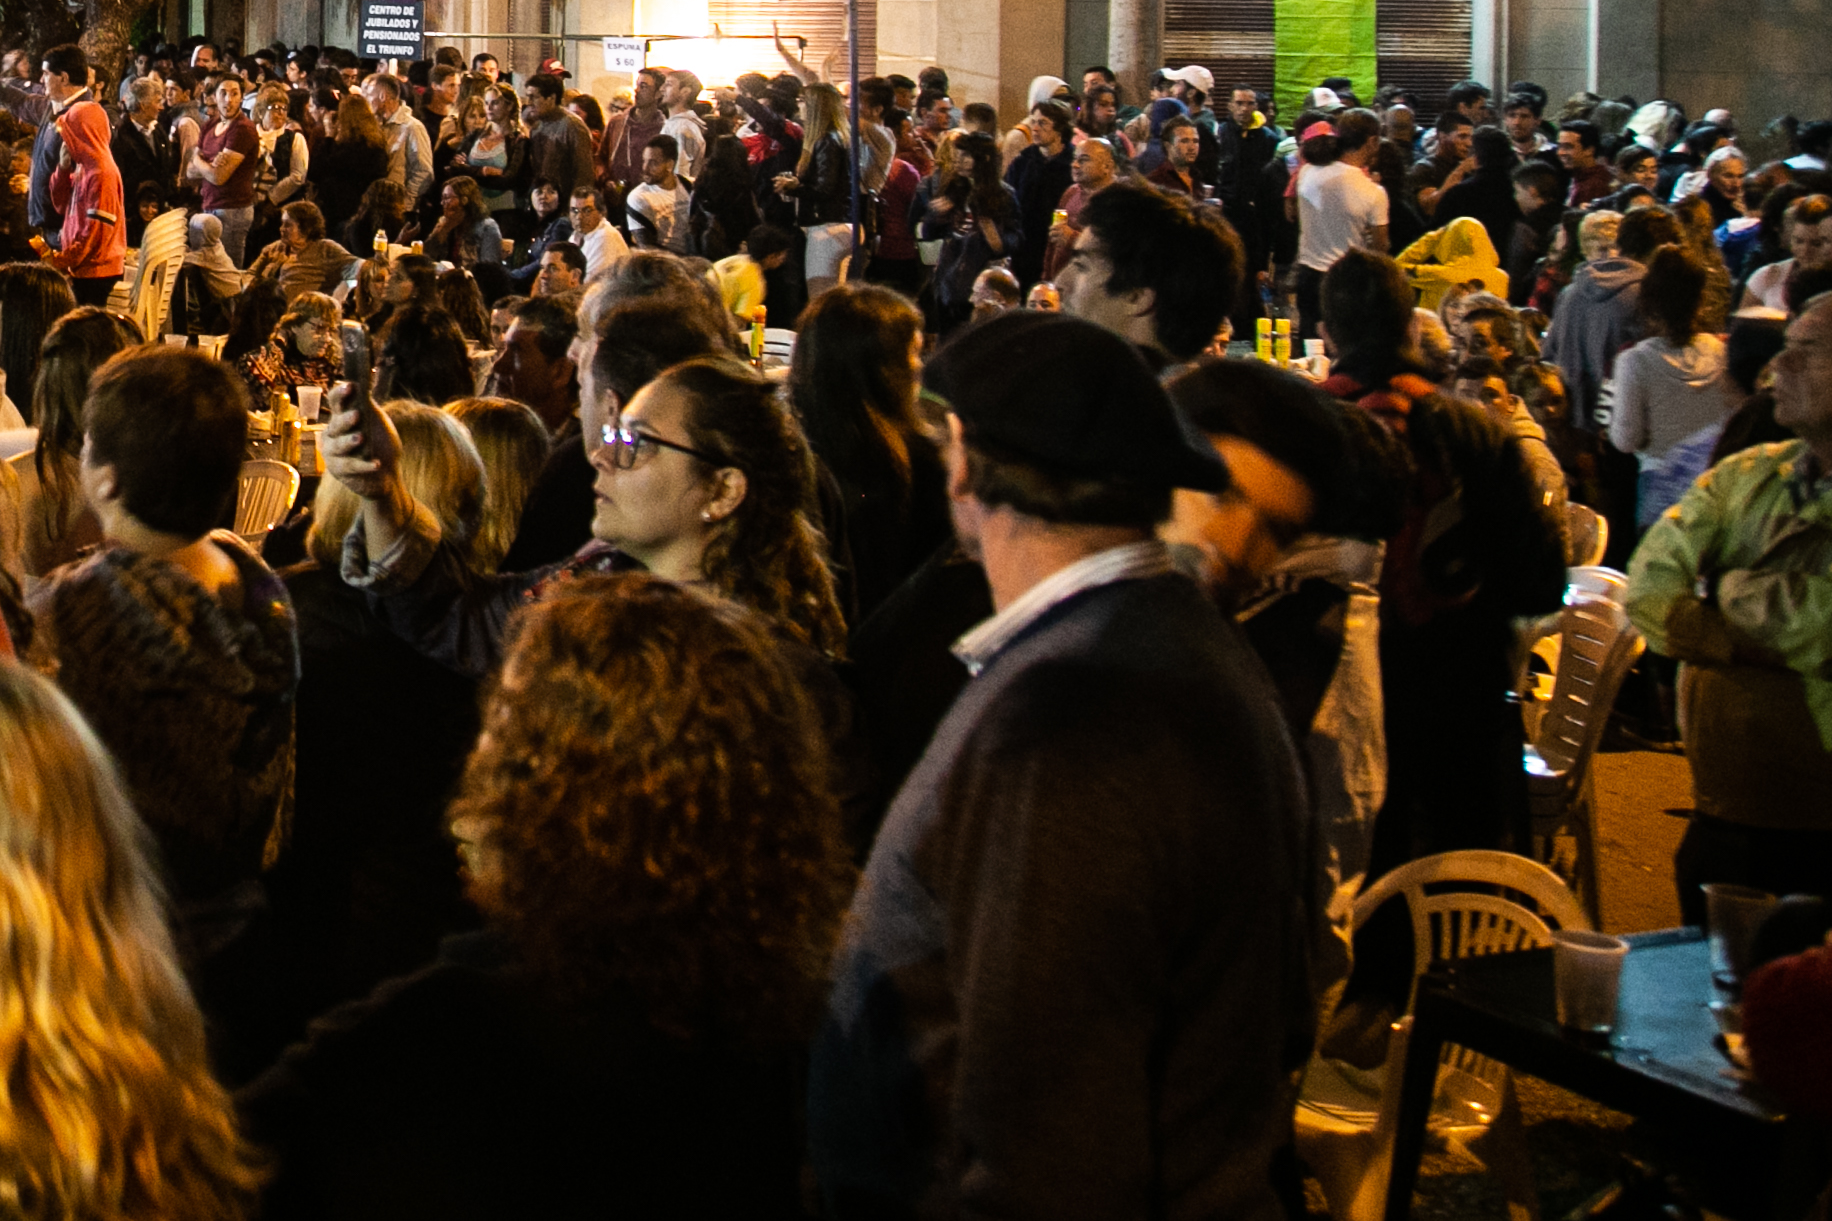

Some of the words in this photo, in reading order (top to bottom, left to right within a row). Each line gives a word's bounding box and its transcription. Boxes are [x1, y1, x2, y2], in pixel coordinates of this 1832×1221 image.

[368, 4, 403, 16] CENTRO
[402, 5, 415, 16] DE
[365, 17, 411, 29] JUBILADOS
[411, 19, 419, 29] Y
[363, 29, 421, 42] PENSIONADOS
[365, 43, 377, 54] EL
[378, 44, 415, 56] TRIUNFO
[607, 42, 642, 51] ESPUMA
[623, 58, 635, 67] 60
